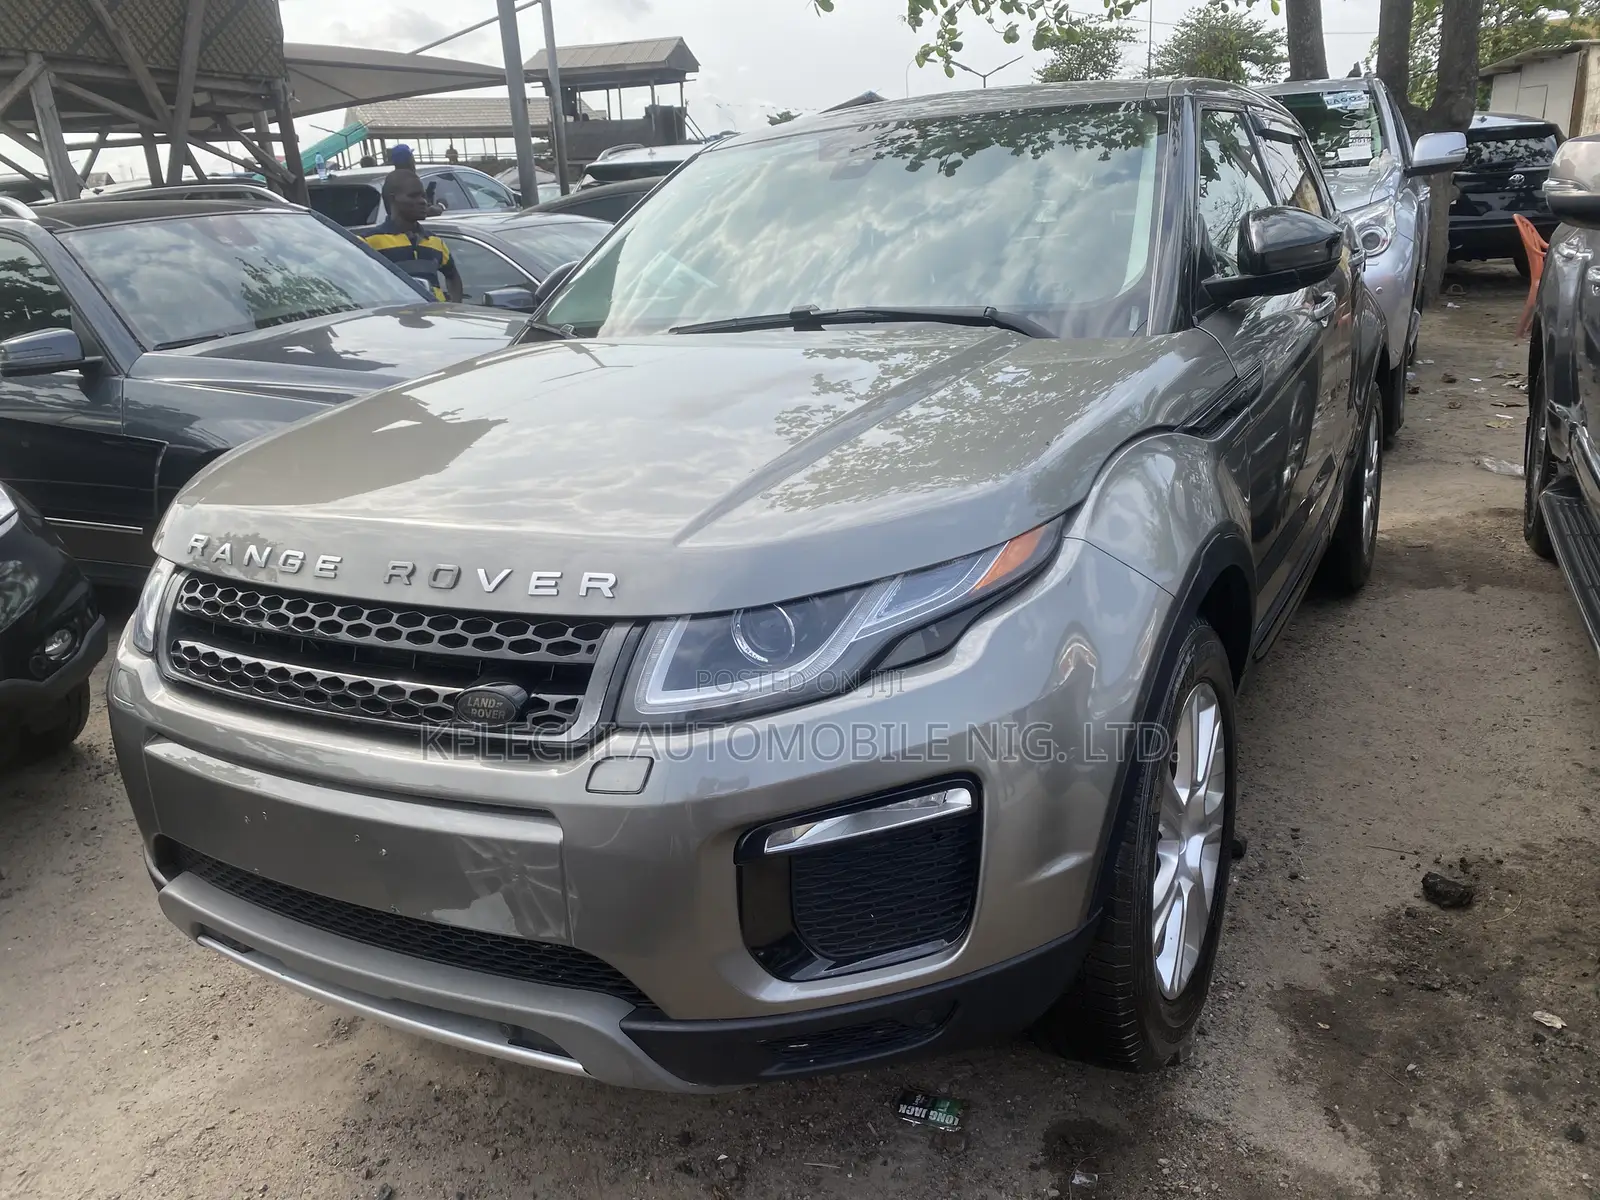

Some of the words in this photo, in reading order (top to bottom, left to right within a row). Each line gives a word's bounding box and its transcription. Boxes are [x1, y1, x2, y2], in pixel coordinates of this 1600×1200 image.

[187, 533, 344, 578] RANGE
[383, 560, 618, 598] ROVER
[467, 696, 496, 709] LAND
[471, 707, 506, 720] ROVER
[898, 1103, 928, 1119] JACK
[928, 1110, 960, 1126] LONG
